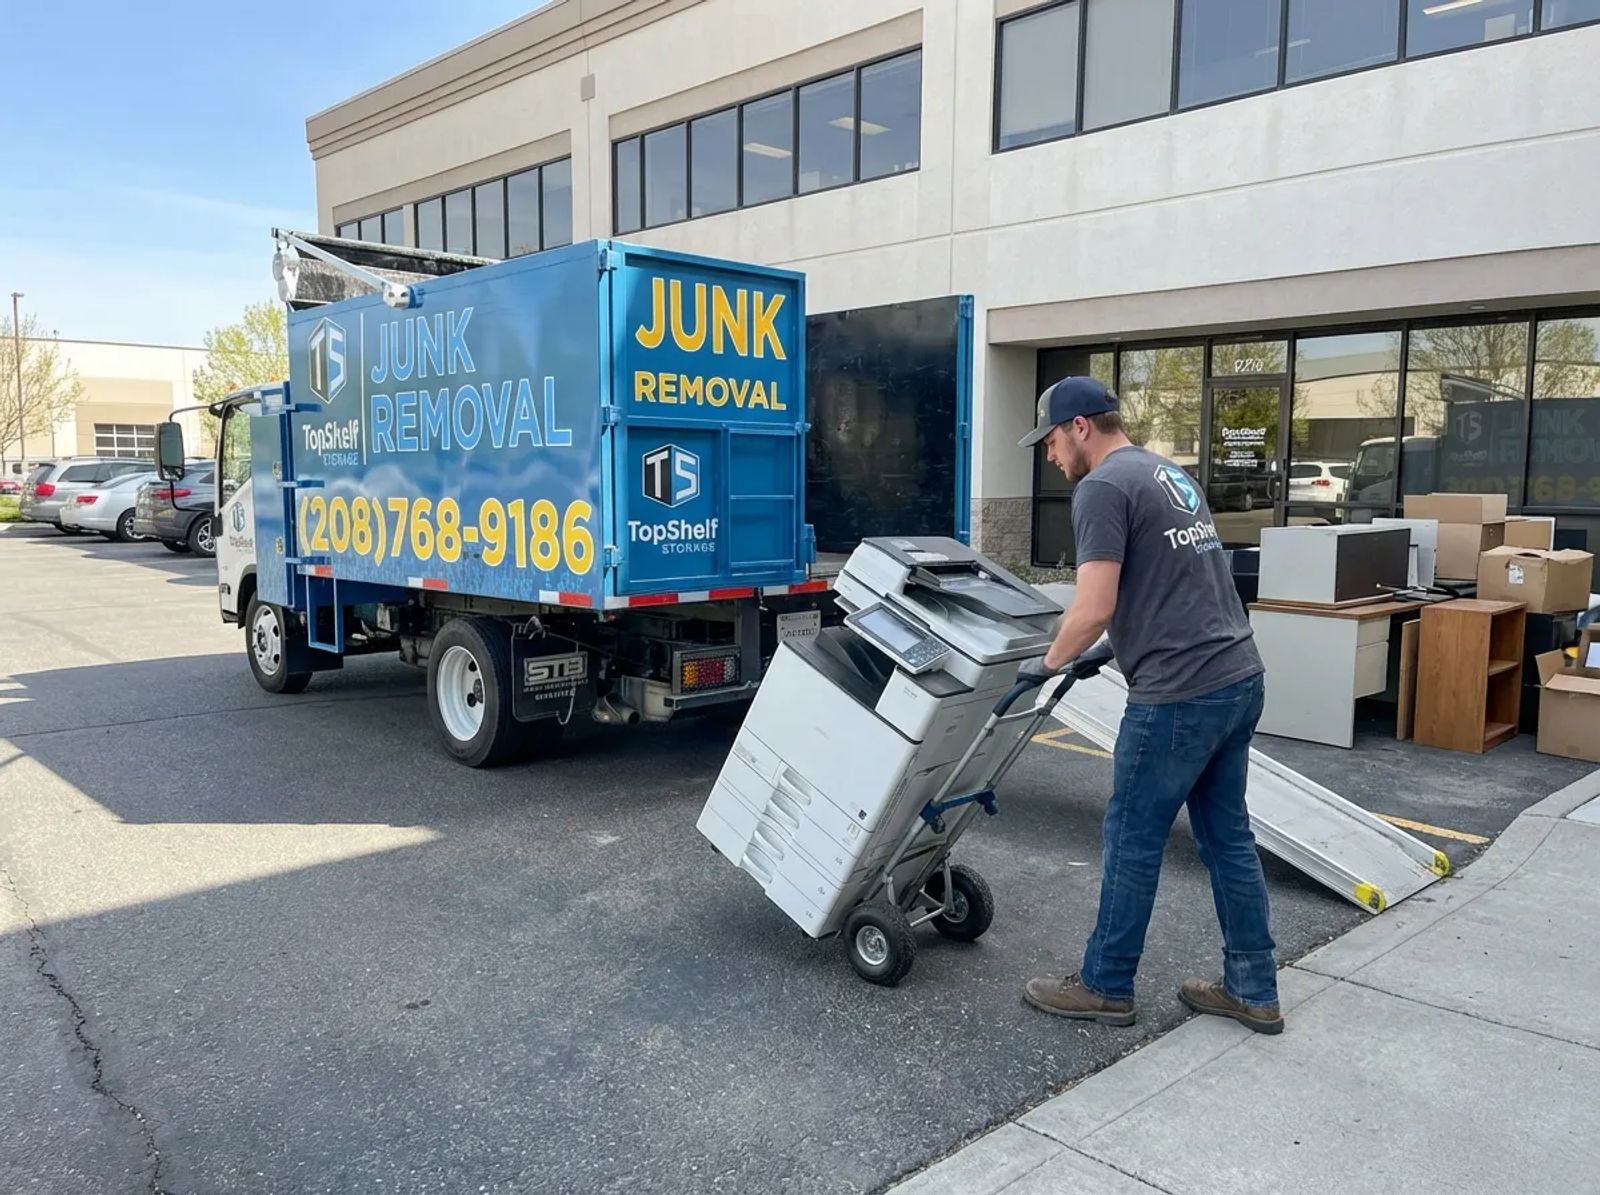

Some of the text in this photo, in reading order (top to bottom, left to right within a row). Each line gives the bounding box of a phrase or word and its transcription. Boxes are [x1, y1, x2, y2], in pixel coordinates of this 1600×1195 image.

[370, 306, 476, 384] JUNK
[634, 276, 787, 361] JUNK
[370, 375, 572, 454] REMOVAL
[634, 370, 787, 411] REMOVAL
[302, 419, 359, 456] TopShelf
[643, 447, 699, 504] TS
[298, 496, 594, 575] (208)768-9186
[628, 517, 719, 545] TopShelf
